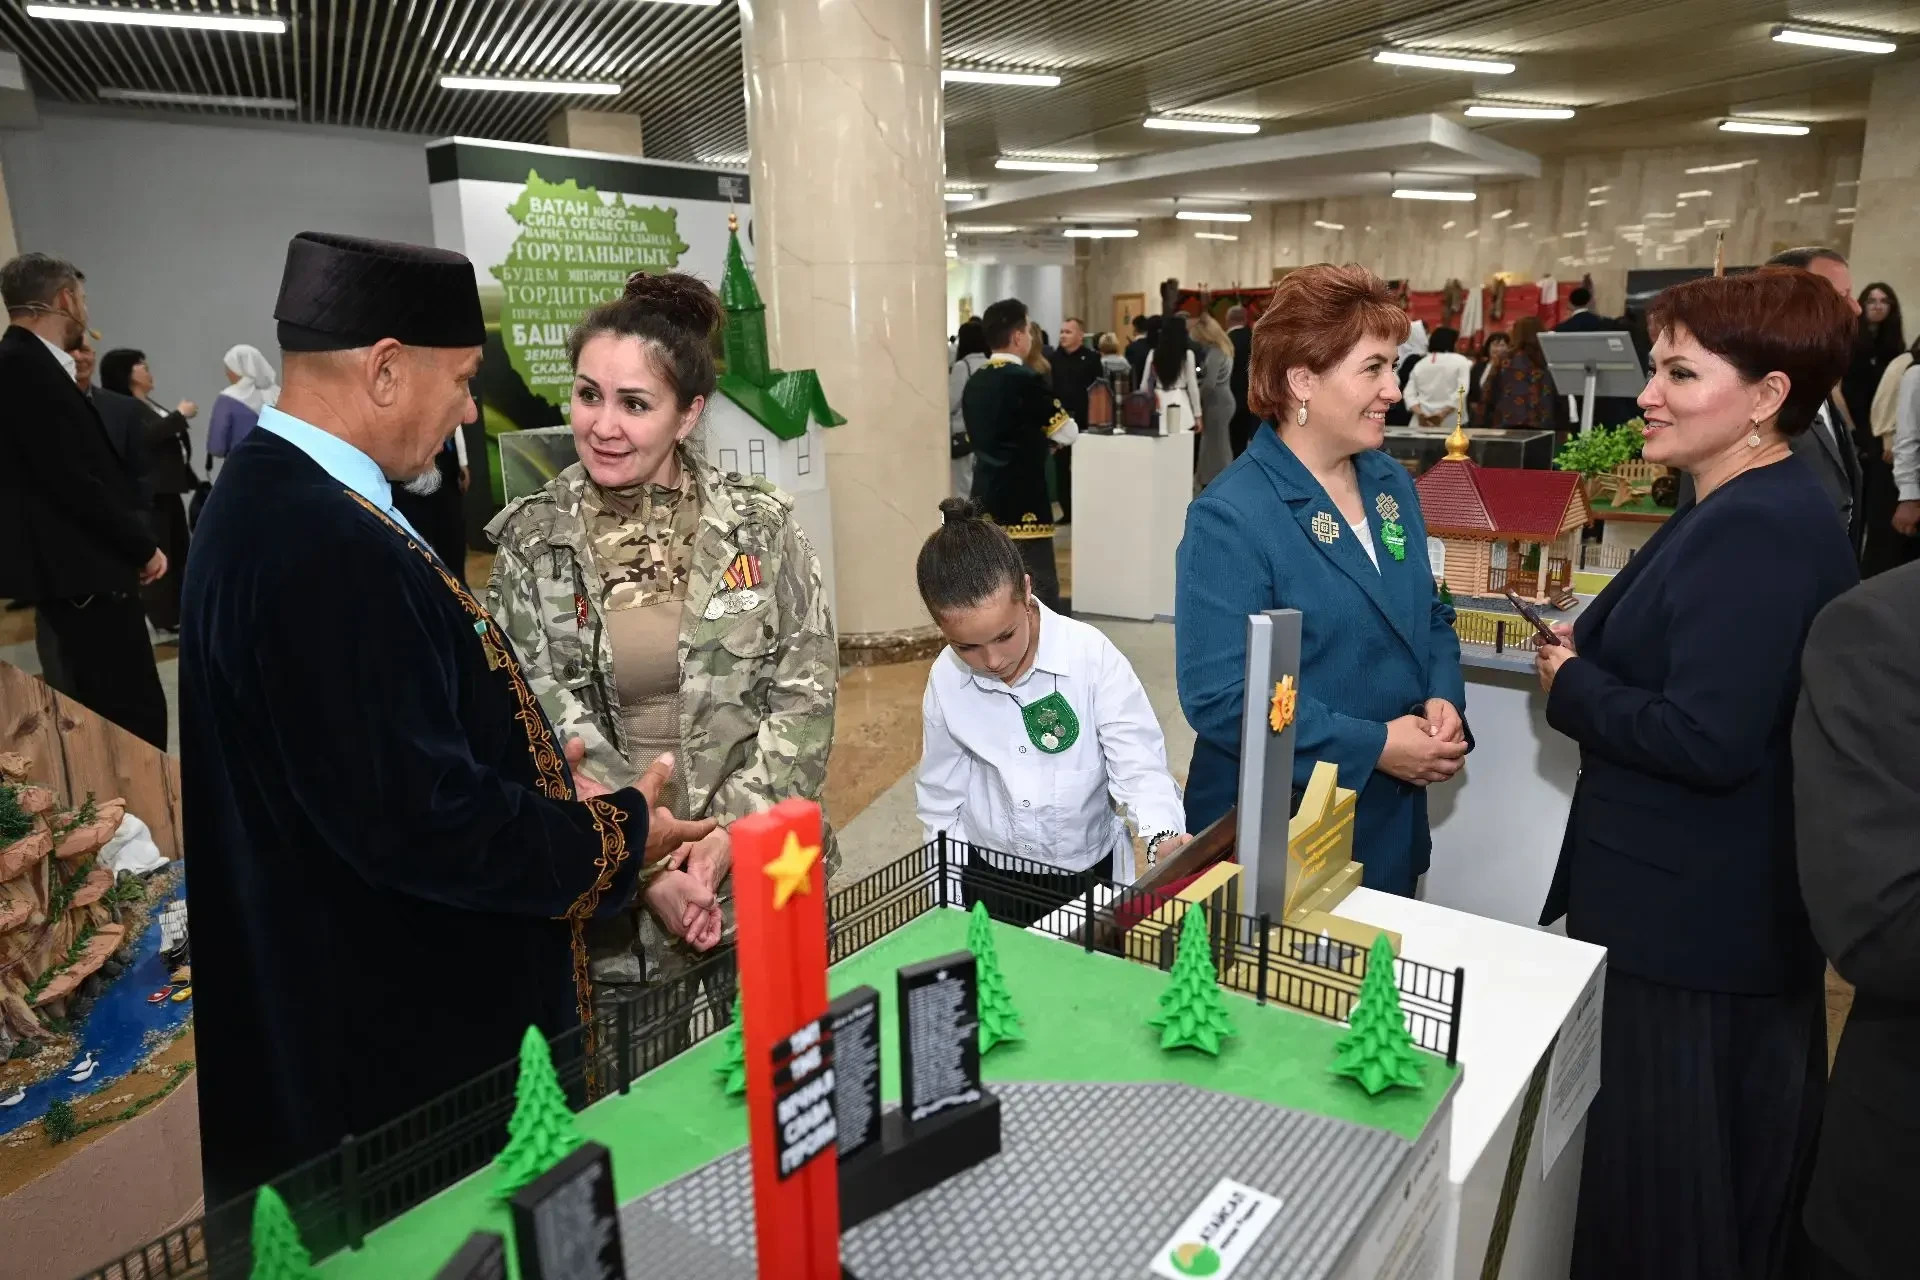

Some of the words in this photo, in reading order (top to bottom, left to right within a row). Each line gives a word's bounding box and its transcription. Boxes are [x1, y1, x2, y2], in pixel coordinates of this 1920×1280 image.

[529, 196, 589, 217] ВАТАН
[525, 212, 567, 228] СИЛА
[570, 216, 649, 233] ОТЕЧЕСТВА
[503, 266, 559, 283] БУДЕМ
[508, 285, 624, 307] ГОРДИТЬСЯ
[512, 308, 551, 320] ПЕРЕД
